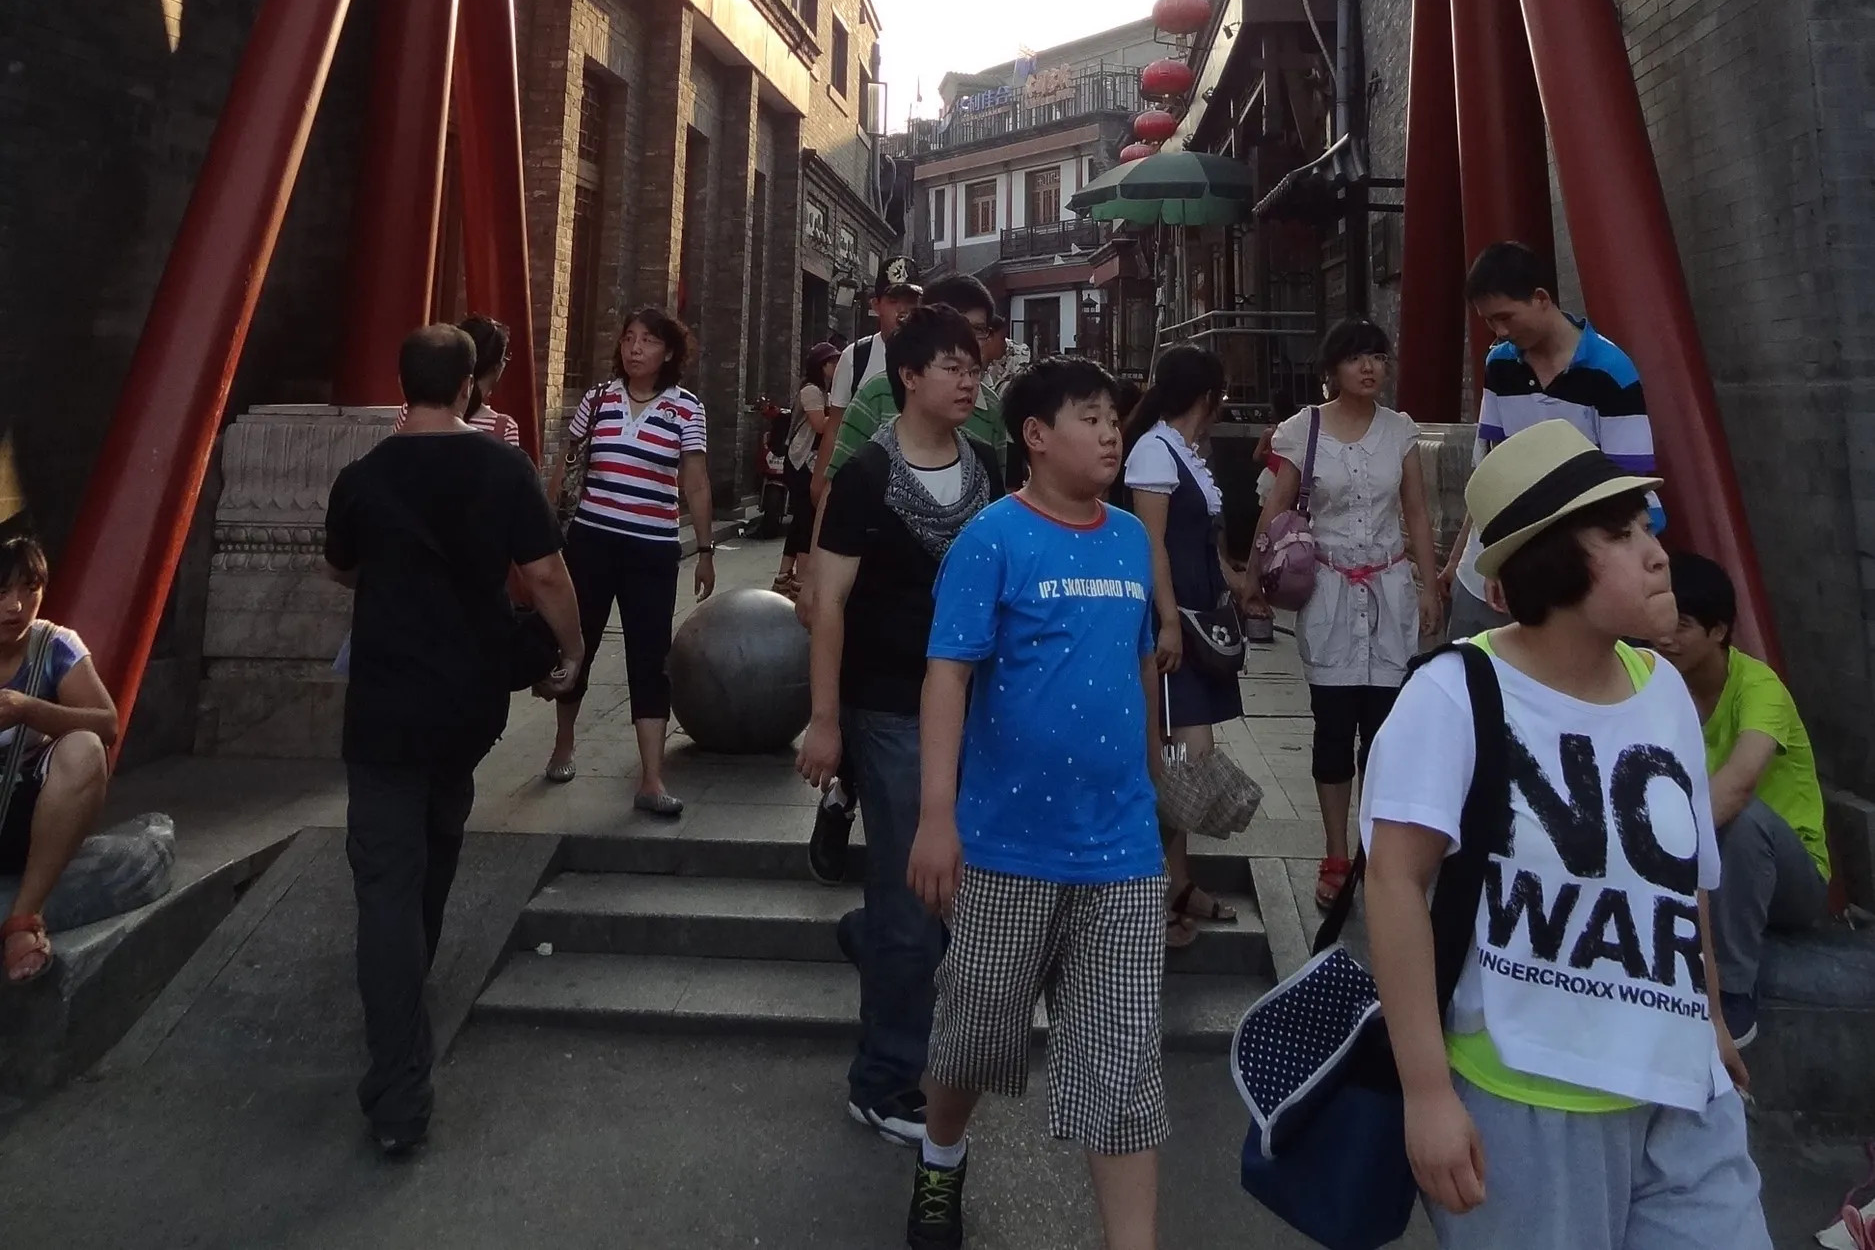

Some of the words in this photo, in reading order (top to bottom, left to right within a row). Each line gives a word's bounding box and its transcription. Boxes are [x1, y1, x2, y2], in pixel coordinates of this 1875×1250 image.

[1062, 578, 1123, 597] SKATEBOARD
[1494, 720, 1699, 897] NO
[1486, 861, 1706, 994] WAR
[1477, 946, 1614, 999] INGERCROXX
[1618, 984, 1710, 1022] WORKnPL
